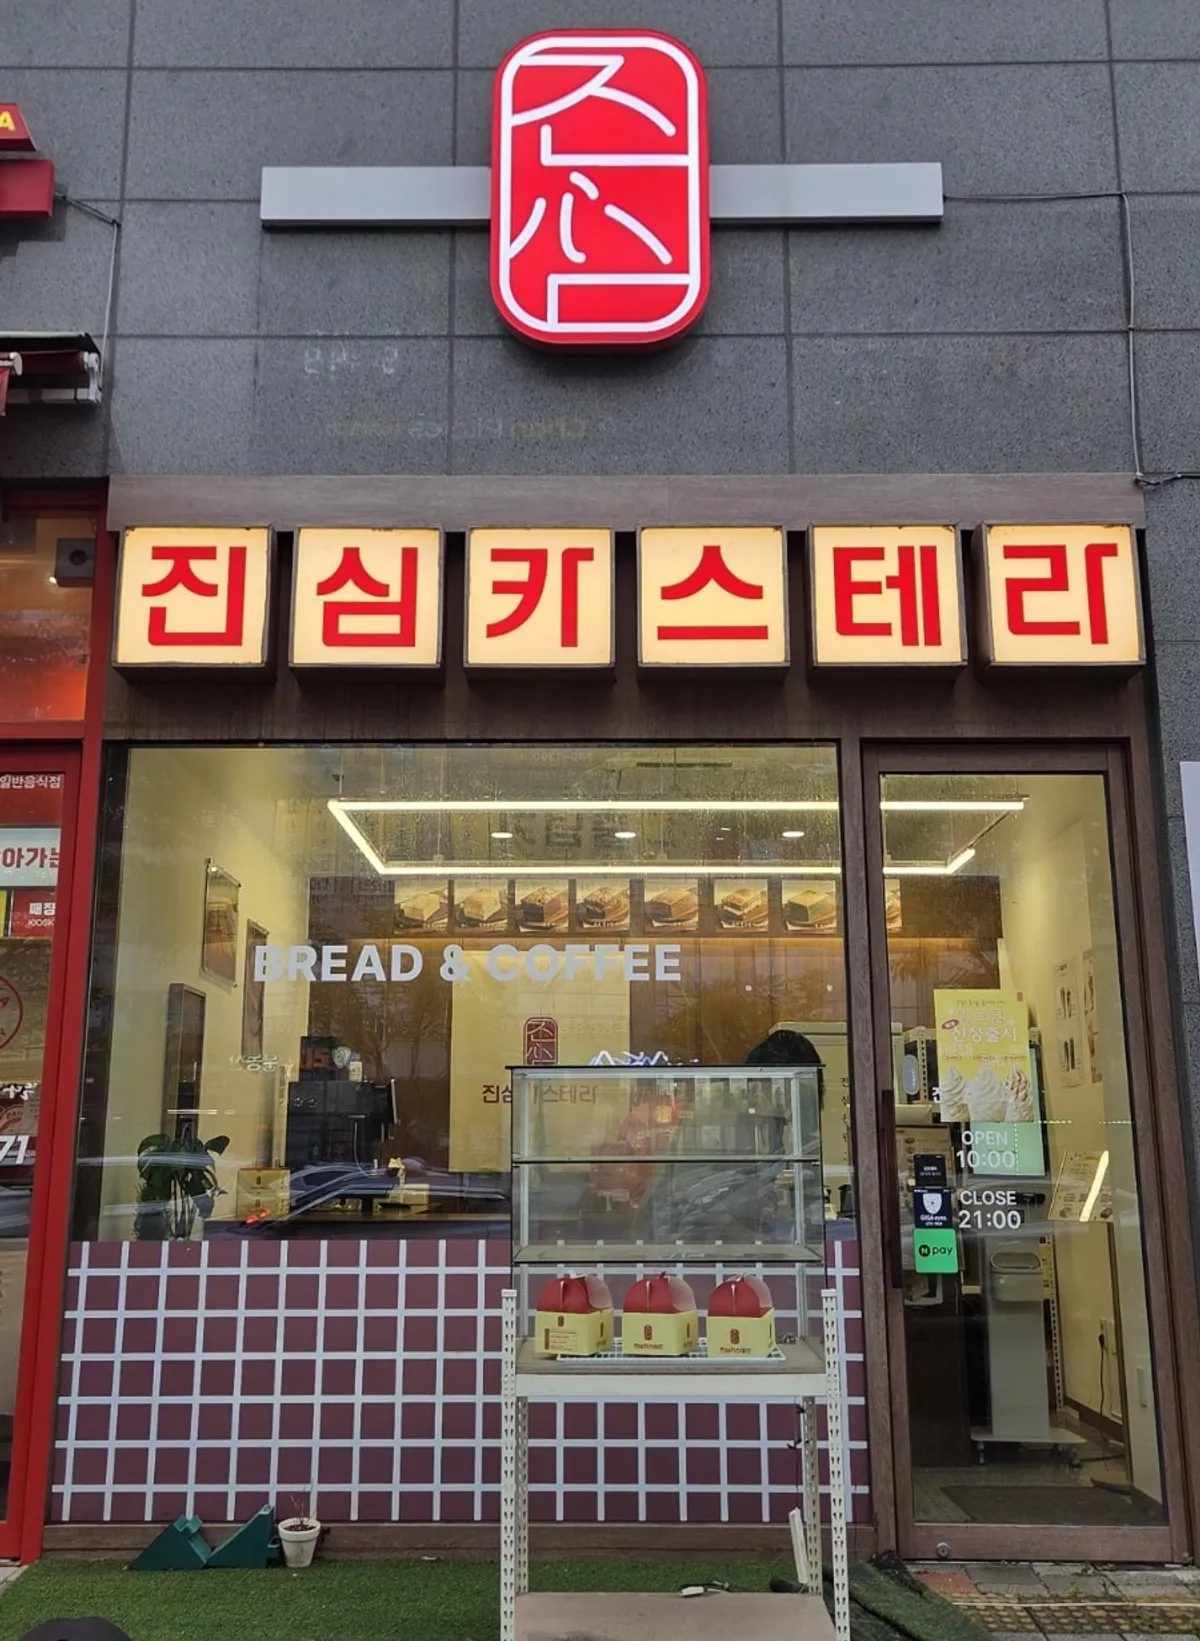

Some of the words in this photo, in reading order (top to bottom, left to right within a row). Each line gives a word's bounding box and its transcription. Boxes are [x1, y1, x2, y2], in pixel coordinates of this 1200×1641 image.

[141, 543, 1118, 648] 진심카스테라
[254, 944, 423, 982] BREAD
[440, 944, 470, 982] &
[487, 944, 682, 982] COFFEE
[961, 1130, 1008, 1146] OPEN
[956, 1150, 1016, 1169] 10:00
[959, 1189, 1017, 1206] CLOSE
[958, 1209, 1021, 1230] 21:00
[932, 1246, 954, 1256] pay
